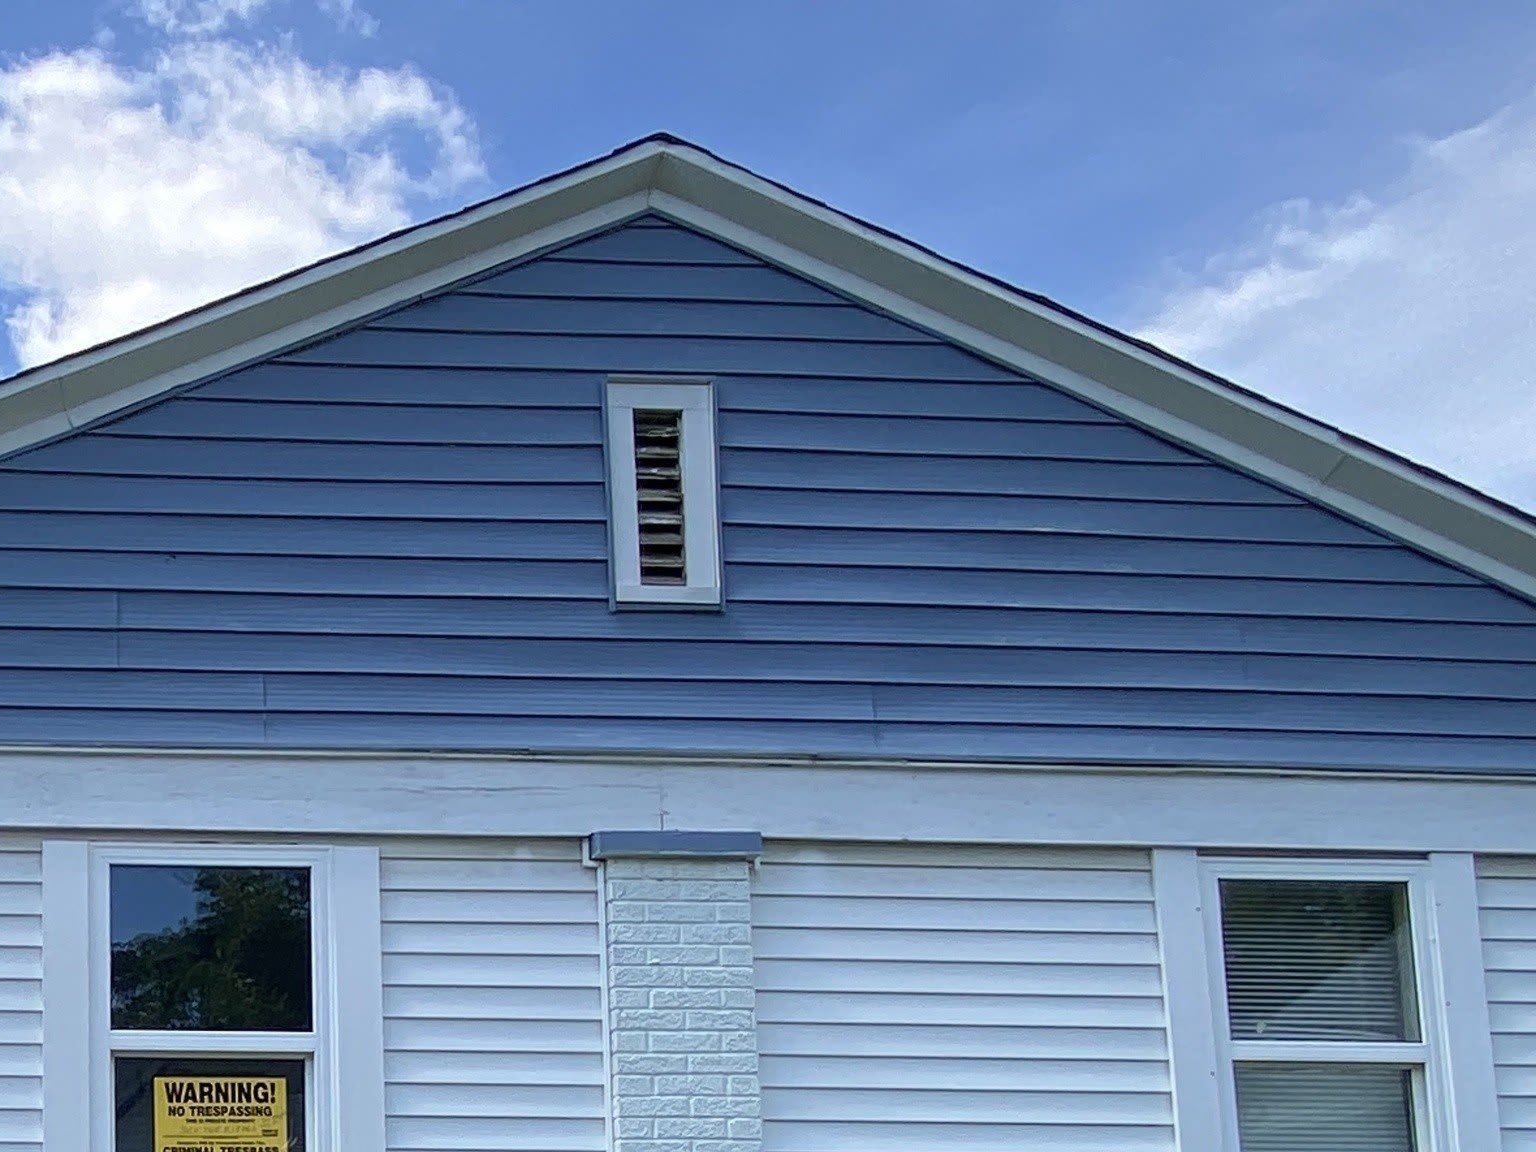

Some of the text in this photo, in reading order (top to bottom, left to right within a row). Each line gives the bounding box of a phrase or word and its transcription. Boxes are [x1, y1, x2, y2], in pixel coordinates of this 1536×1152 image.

[164, 1082, 276, 1104] WARNING!
[168, 1106, 273, 1117] NO TRESPASSING
